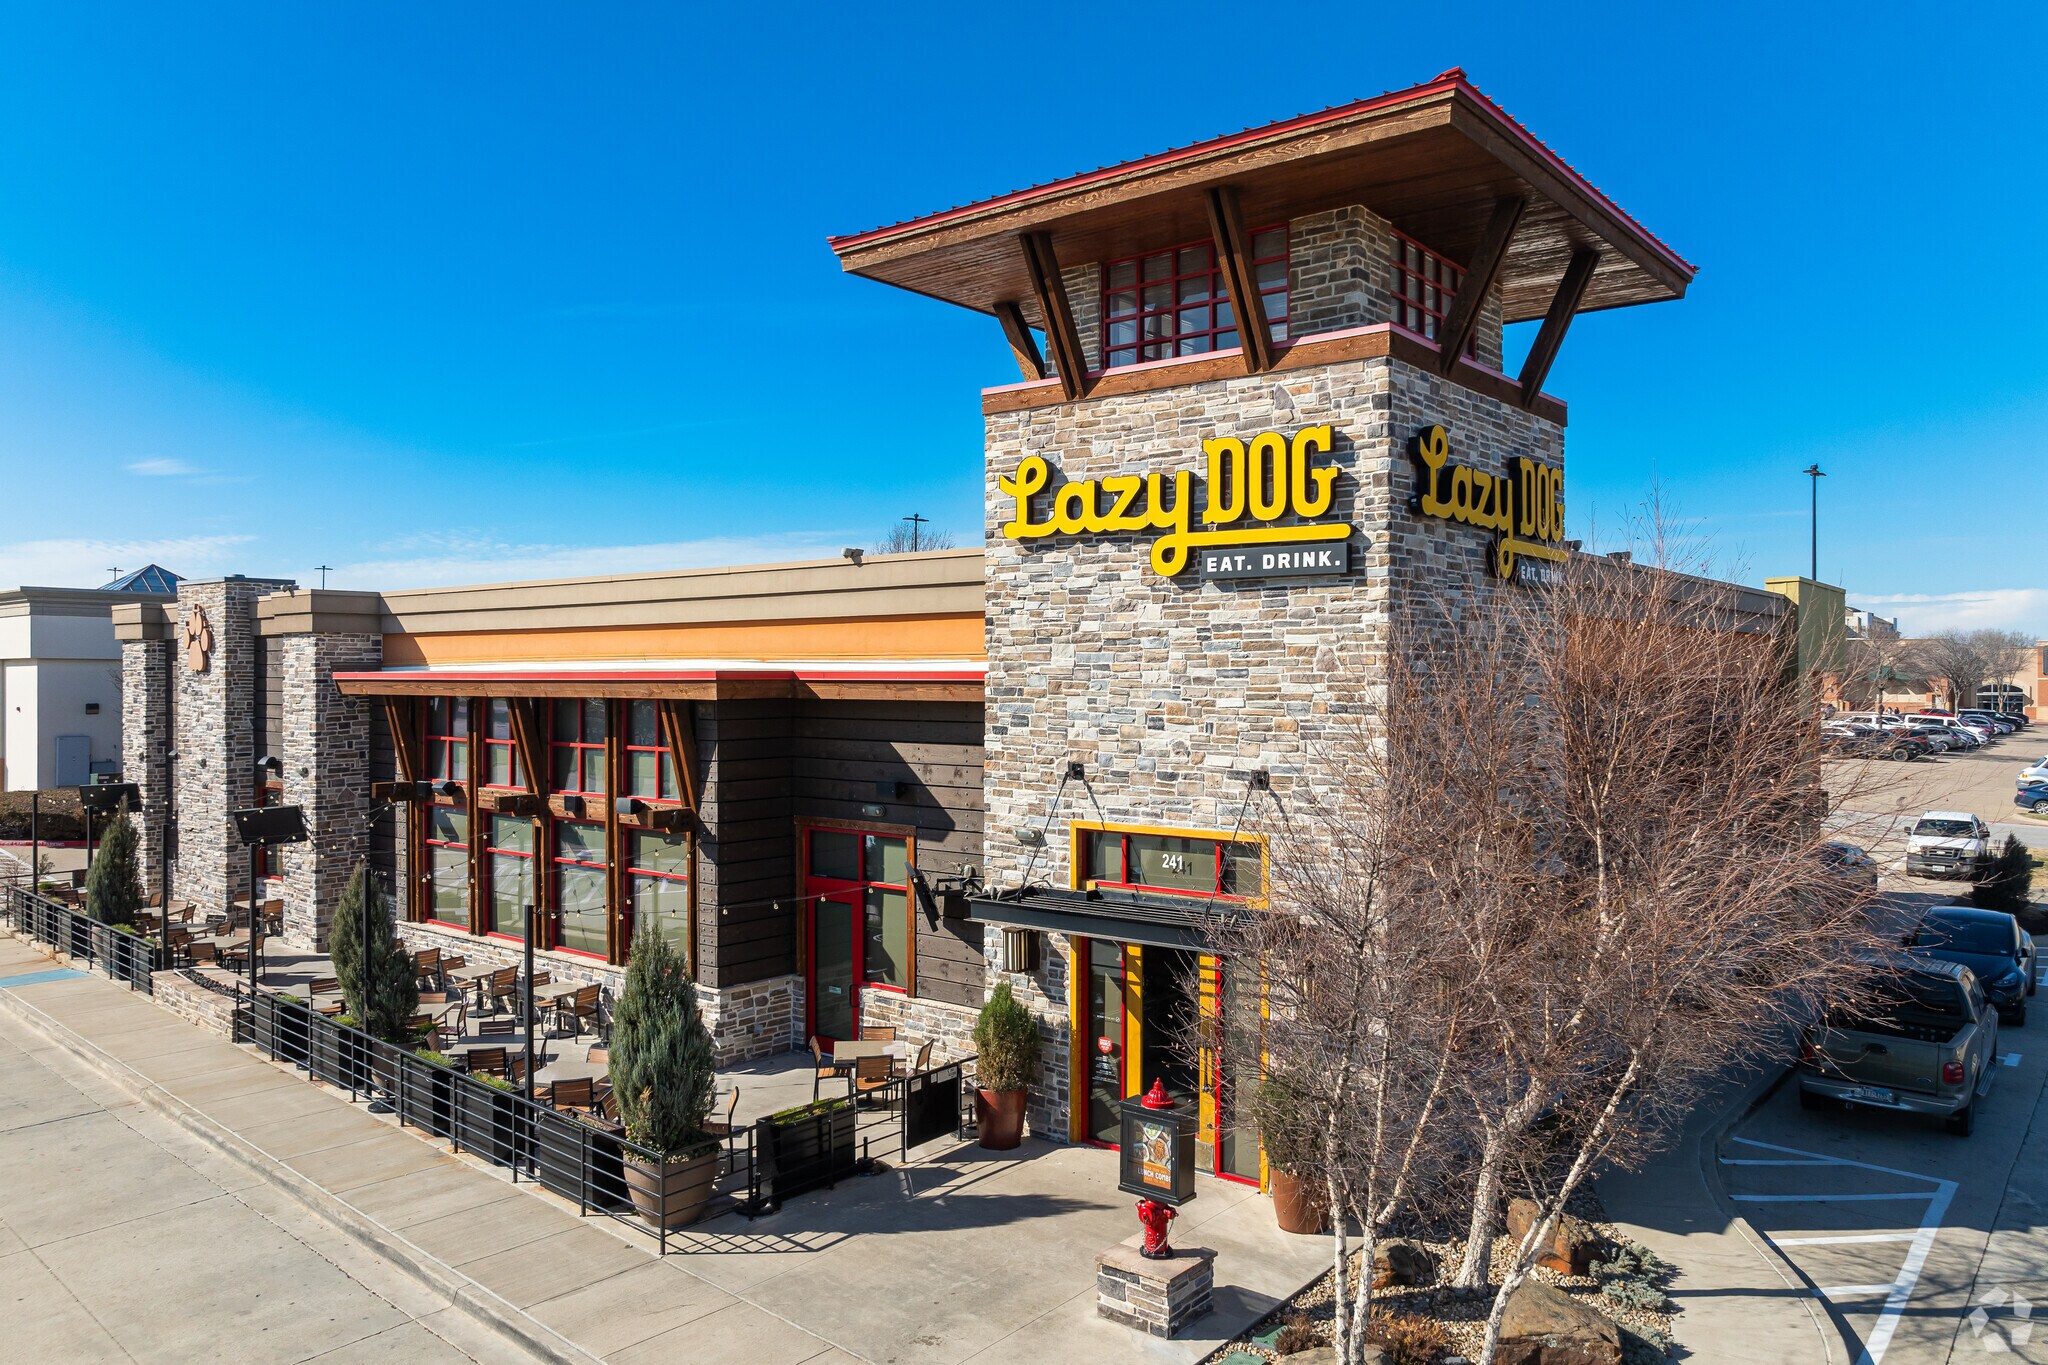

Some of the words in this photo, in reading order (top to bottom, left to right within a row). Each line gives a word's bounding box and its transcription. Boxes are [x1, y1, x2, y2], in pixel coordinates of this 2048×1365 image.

[999, 456, 1190, 577] Lazy
[1202, 425, 1342, 524] DOG
[1419, 424, 1514, 579] Lazy
[1519, 457, 1565, 543] DOG
[1206, 555, 1252, 572] EAT.
[1262, 550, 1340, 570] DRINK.
[1161, 853, 1184, 869] 241
